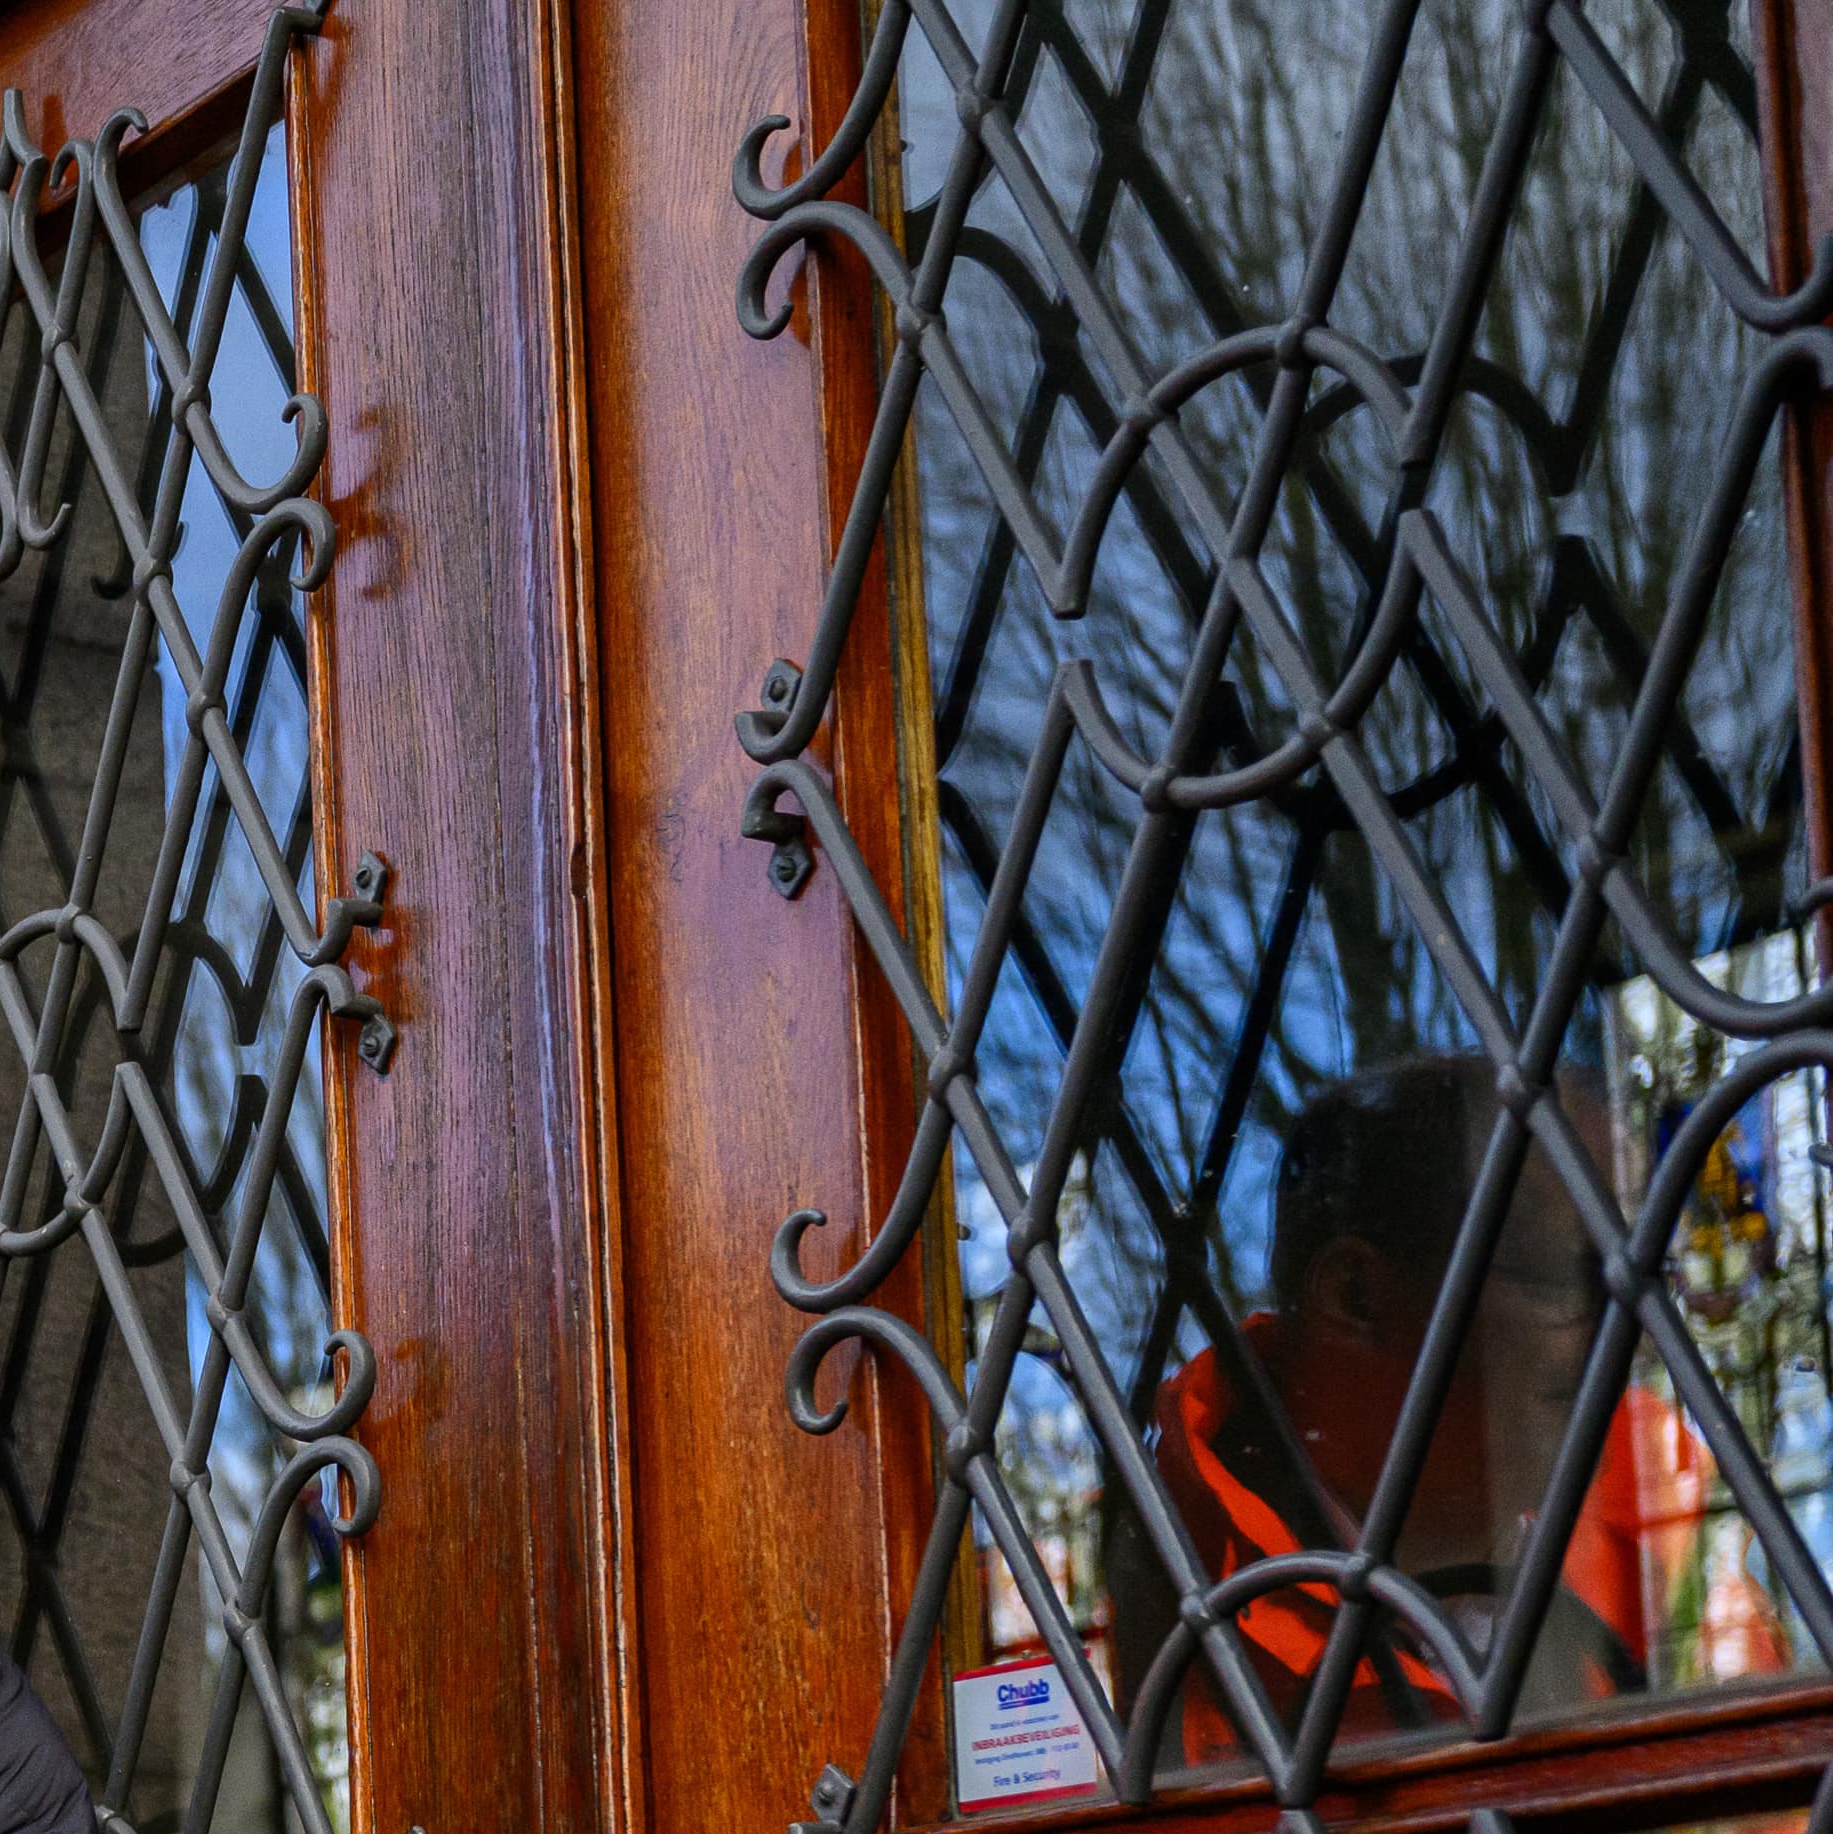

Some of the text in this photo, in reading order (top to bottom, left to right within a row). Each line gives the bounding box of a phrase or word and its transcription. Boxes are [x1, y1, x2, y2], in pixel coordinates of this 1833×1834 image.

[997, 1679, 1050, 1702] Chubb
[972, 1724, 1080, 1751] INBRAAKBEVEILIGING
[993, 1769, 1061, 1787] Fire & Security
